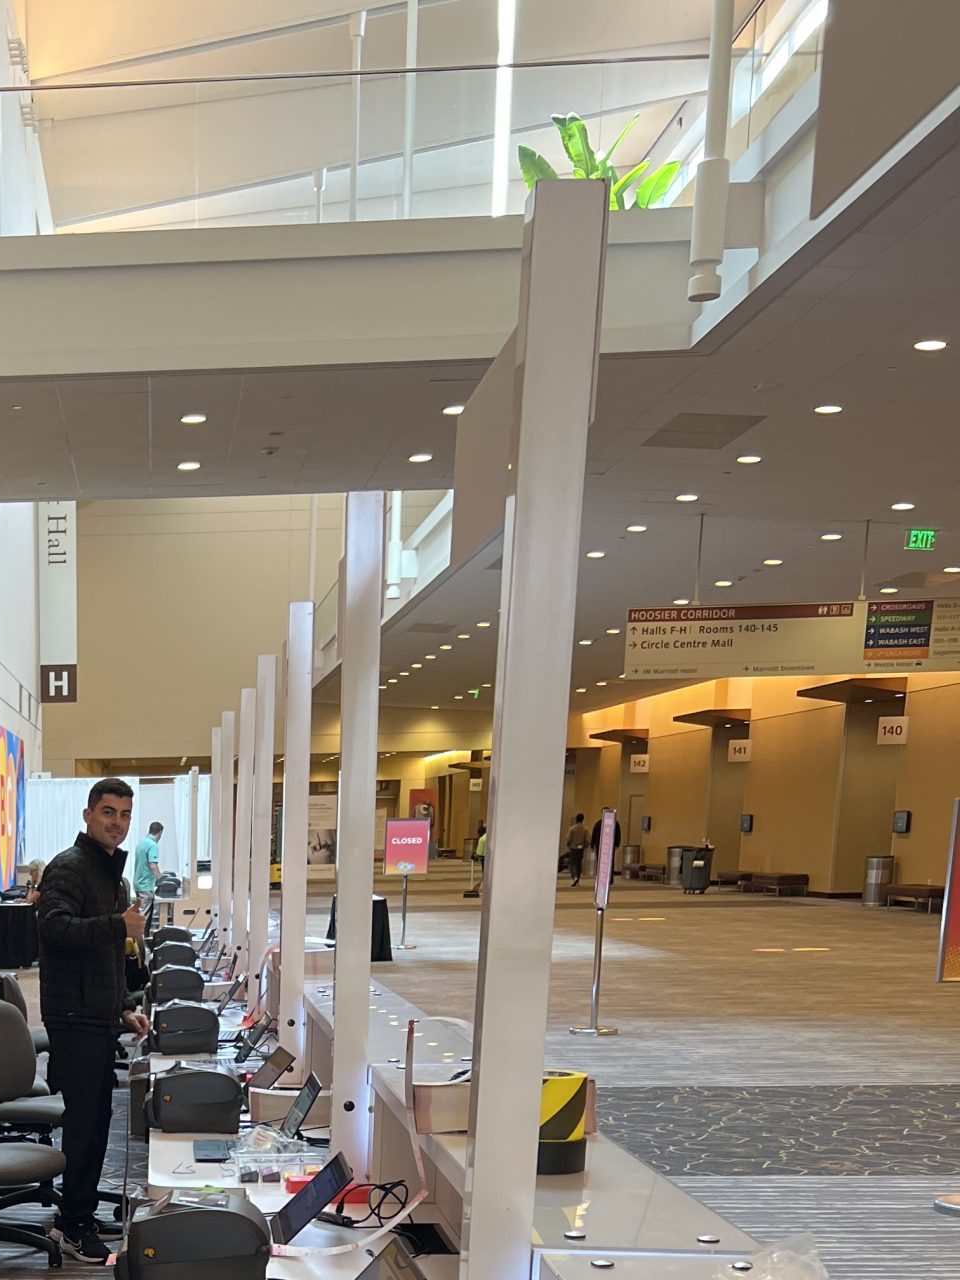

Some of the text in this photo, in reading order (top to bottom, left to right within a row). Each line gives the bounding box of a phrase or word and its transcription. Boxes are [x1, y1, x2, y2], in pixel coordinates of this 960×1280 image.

[47, 514, 68, 566] Hall
[908, 530, 935, 549] EXIT
[881, 603, 926, 611] CROSSROADS
[631, 608, 736, 621] HOOSIER CORRIDOR
[879, 615, 916, 623] SPEEDWAY
[641, 625, 687, 636] Halls F-H
[698, 623, 779, 635] Rooms 140-145
[879, 626, 909, 634] WABASH
[640, 637, 733, 650] Circle Centre Mall
[878, 638, 908, 646] WABASH
[48, 670, 69, 697] H
[881, 724, 904, 737] 140
[731, 746, 748, 756] 141
[632, 759, 647, 769] 142
[391, 836, 423, 845] CLOSED
